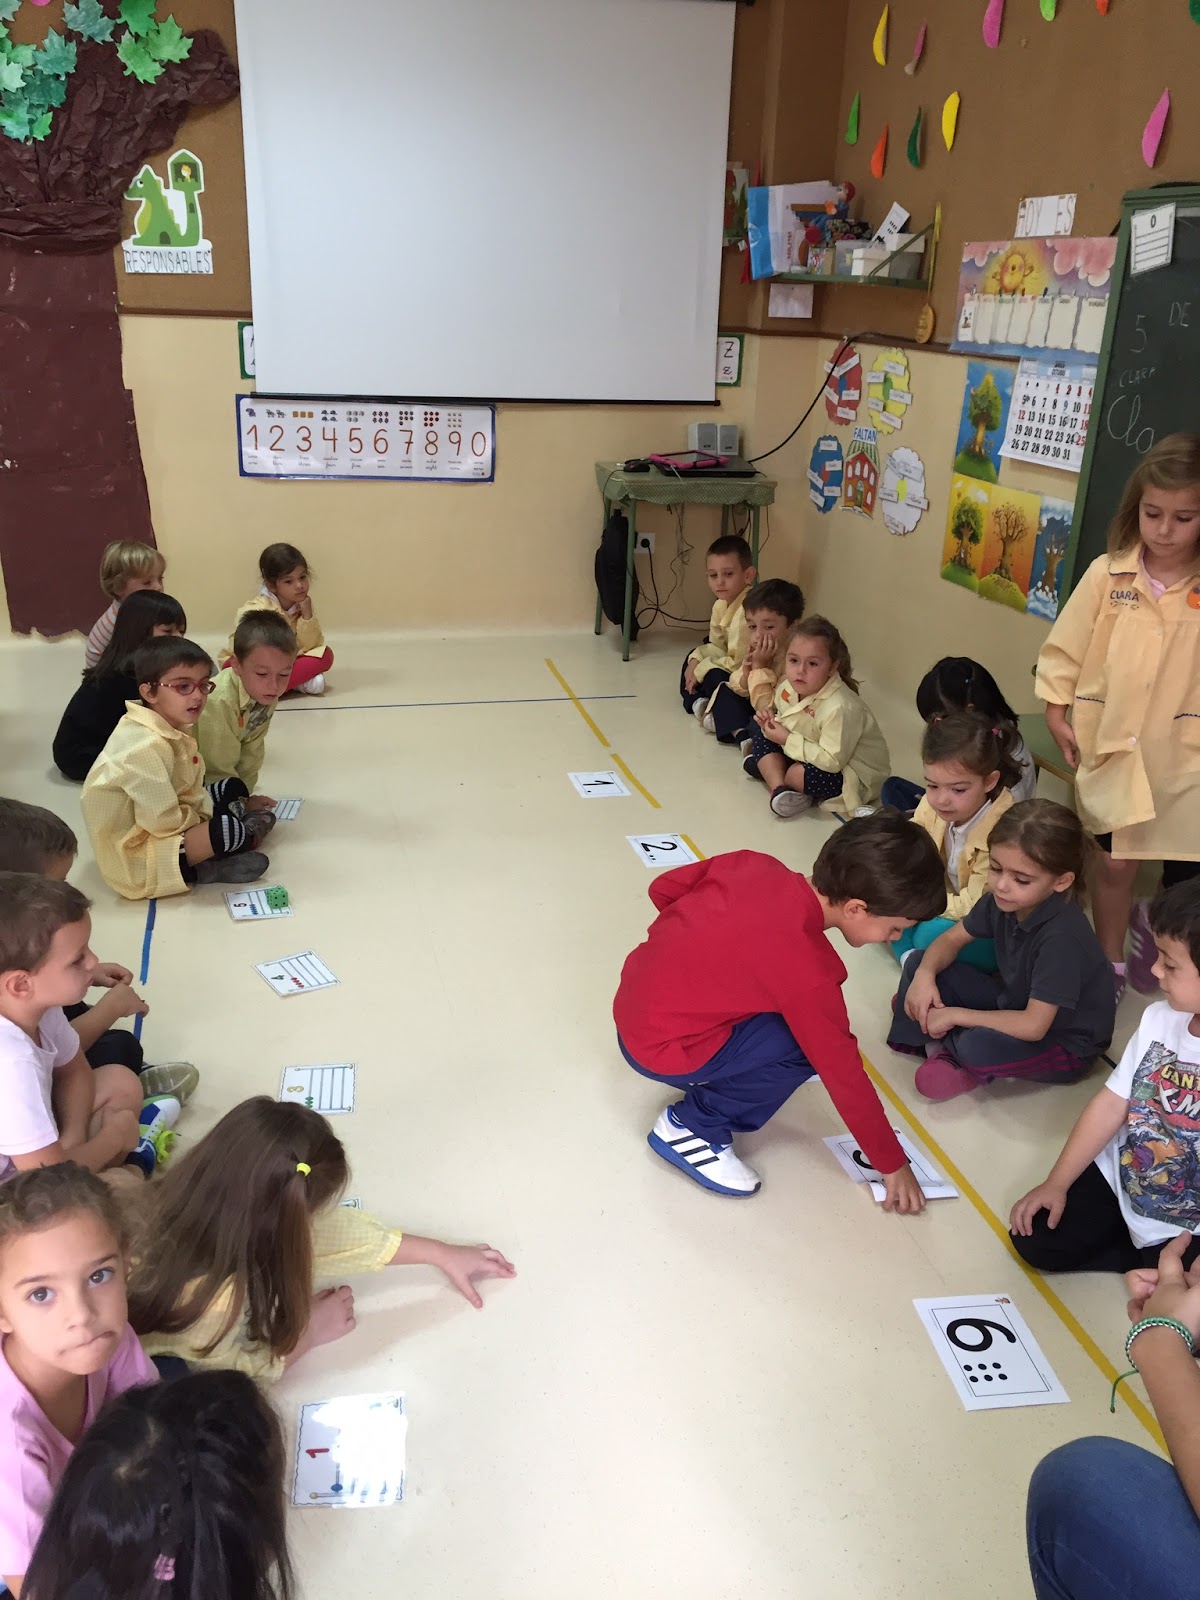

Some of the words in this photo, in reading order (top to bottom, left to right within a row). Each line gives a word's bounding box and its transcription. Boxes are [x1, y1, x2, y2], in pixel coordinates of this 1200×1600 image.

[1055, 196, 1077, 235] ES
[125, 250, 211, 273] RESPONSABLES
[1168, 302, 1191, 327] DE
[1130, 314, 1147, 353] 5
[724, 341, 734, 358] Z
[1066, 384, 1072, 395] 2
[1031, 396, 1036, 406] 6
[1042, 398, 1047, 408] 7
[1052, 399, 1057, 409] 8
[1063, 400, 1068, 411] 9
[1073, 402, 1081, 413] 10
[1018, 410, 1025, 420] 12
[1028, 411, 1035, 421] 13
[1038, 413, 1045, 423] 14
[1048, 414, 1056, 425] 15
[1059, 416, 1067, 427] 16
[1070, 418, 1078, 429] 17
[1080, 419, 1088, 430] 18
[247, 424, 257, 450] 1
[270, 425, 285, 451] 2
[297, 426, 312, 452] 3
[322, 427, 338, 452] 4
[349, 428, 363, 453] 5
[374, 429, 388, 454] 6
[399, 429, 413, 454] 7
[425, 431, 438, 455] 8
[449, 431, 461, 456] 9
[472, 432, 486, 456] 0
[853, 427, 877, 442] FALTAN
[1015, 424, 1022, 434] 19
[1024, 426, 1032, 436] 20
[1034, 428, 1042, 438] 21
[1045, 430, 1053, 440] 22
[1055, 432, 1064, 442] 23
[1066, 434, 1074, 444] 24
[1076, 435, 1085, 446] 25
[1011, 439, 1019, 449] 26
[1021, 441, 1029, 451] 27
[1031, 443, 1040, 453] 28
[1041, 445, 1050, 455] 29
[1052, 447, 1060, 458] 30
[1062, 449, 1070, 460] 31
[1109, 590, 1140, 602] CLARA
[640, 841, 678, 852] 2
[946, 1317, 1017, 1352] 6
[305, 1447, 330, 1459] 1
